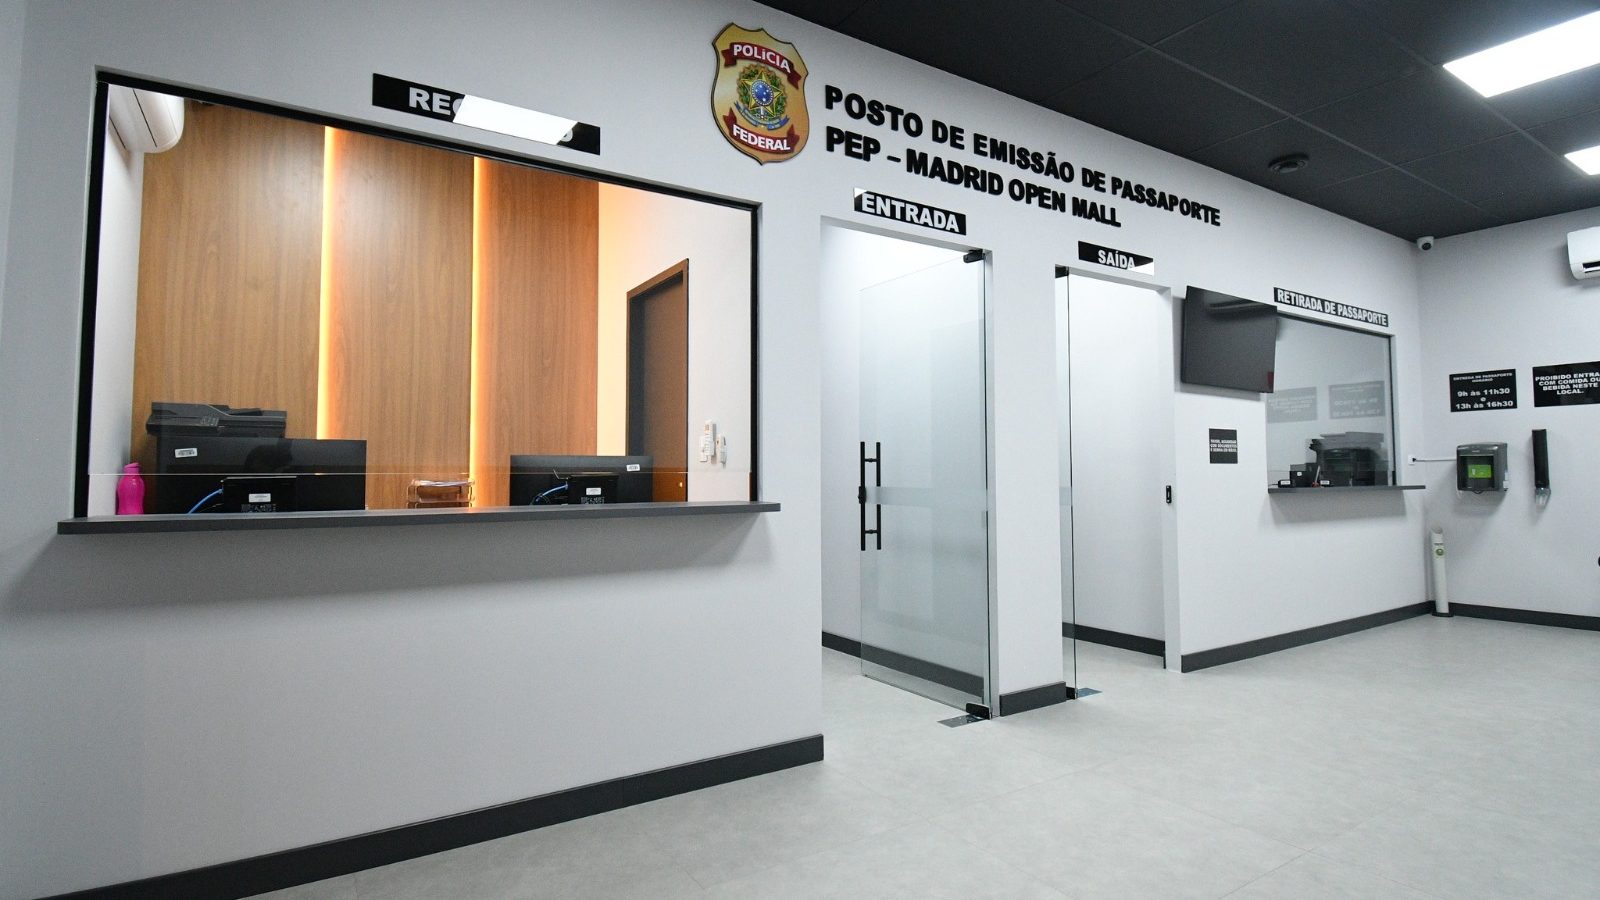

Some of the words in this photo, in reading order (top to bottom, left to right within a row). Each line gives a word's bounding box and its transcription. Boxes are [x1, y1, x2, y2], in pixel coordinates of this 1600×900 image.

[732, 124, 791, 151] FEDERAL
[825, 84, 923, 138] POSTO
[931, 119, 965, 150] DE
[973, 132, 1075, 183] EMISSÃO
[1081, 167, 1106, 193] DE
[1111, 176, 1221, 227] PASSAPORTE
[826, 125, 881, 162] PEP
[906, 148, 1004, 196] MADRID
[1008, 178, 1066, 213] OPEN
[1072, 196, 1122, 228] MALL
[861, 192, 960, 233] ENTRADA
[1098, 249, 1136, 270] SAÍDA
[1277, 288, 1323, 312] RETIRADA
[1324, 301, 1336, 315] DE
[1337, 304, 1387, 326] PASSAPORTE
[1483, 387, 1510, 395] 11h30
[1486, 400, 1514, 408] 16h30
